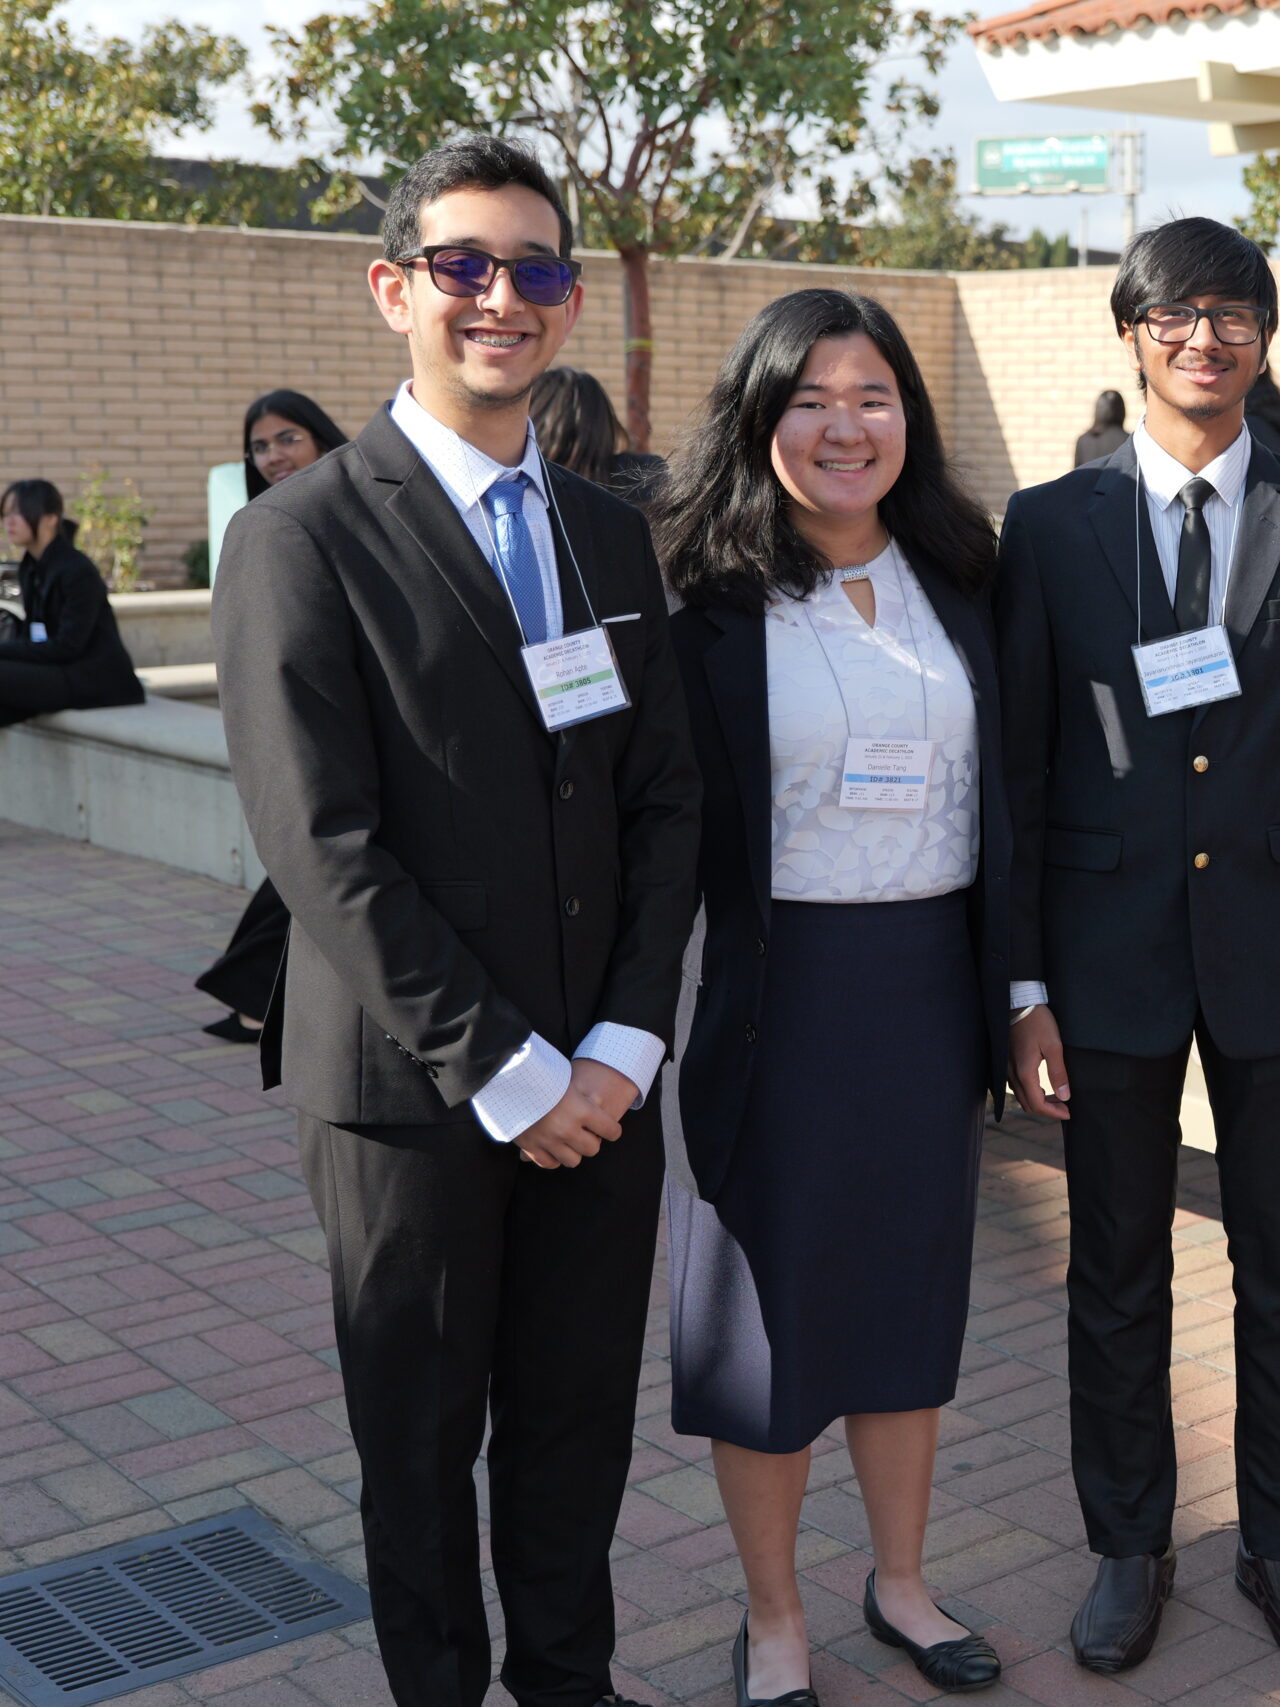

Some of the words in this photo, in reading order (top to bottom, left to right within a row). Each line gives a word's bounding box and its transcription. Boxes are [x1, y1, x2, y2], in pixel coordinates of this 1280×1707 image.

[560, 683, 573, 692] ID#
[575, 677, 591, 687] 3805
[893, 764, 907, 772] Tang
